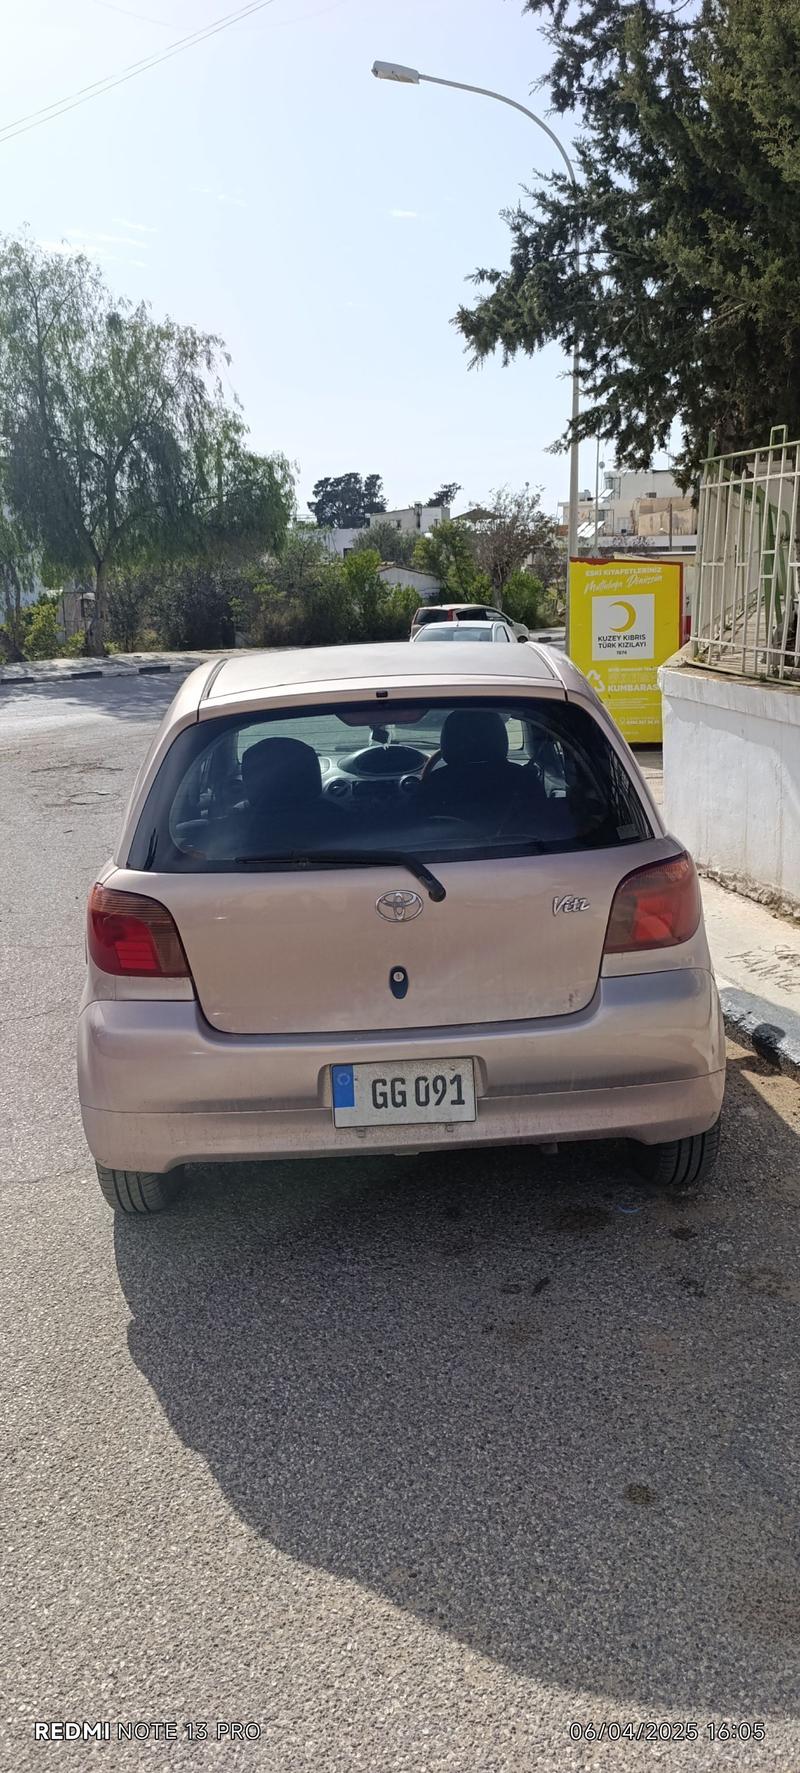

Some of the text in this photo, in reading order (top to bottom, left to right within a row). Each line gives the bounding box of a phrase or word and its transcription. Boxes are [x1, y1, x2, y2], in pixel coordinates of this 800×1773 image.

[598, 641, 616, 649] TÜRK
[608, 683, 660, 693] KUMBARAS
[552, 894, 590, 917] Vitz
[371, 1074, 466, 1109] GG 091
